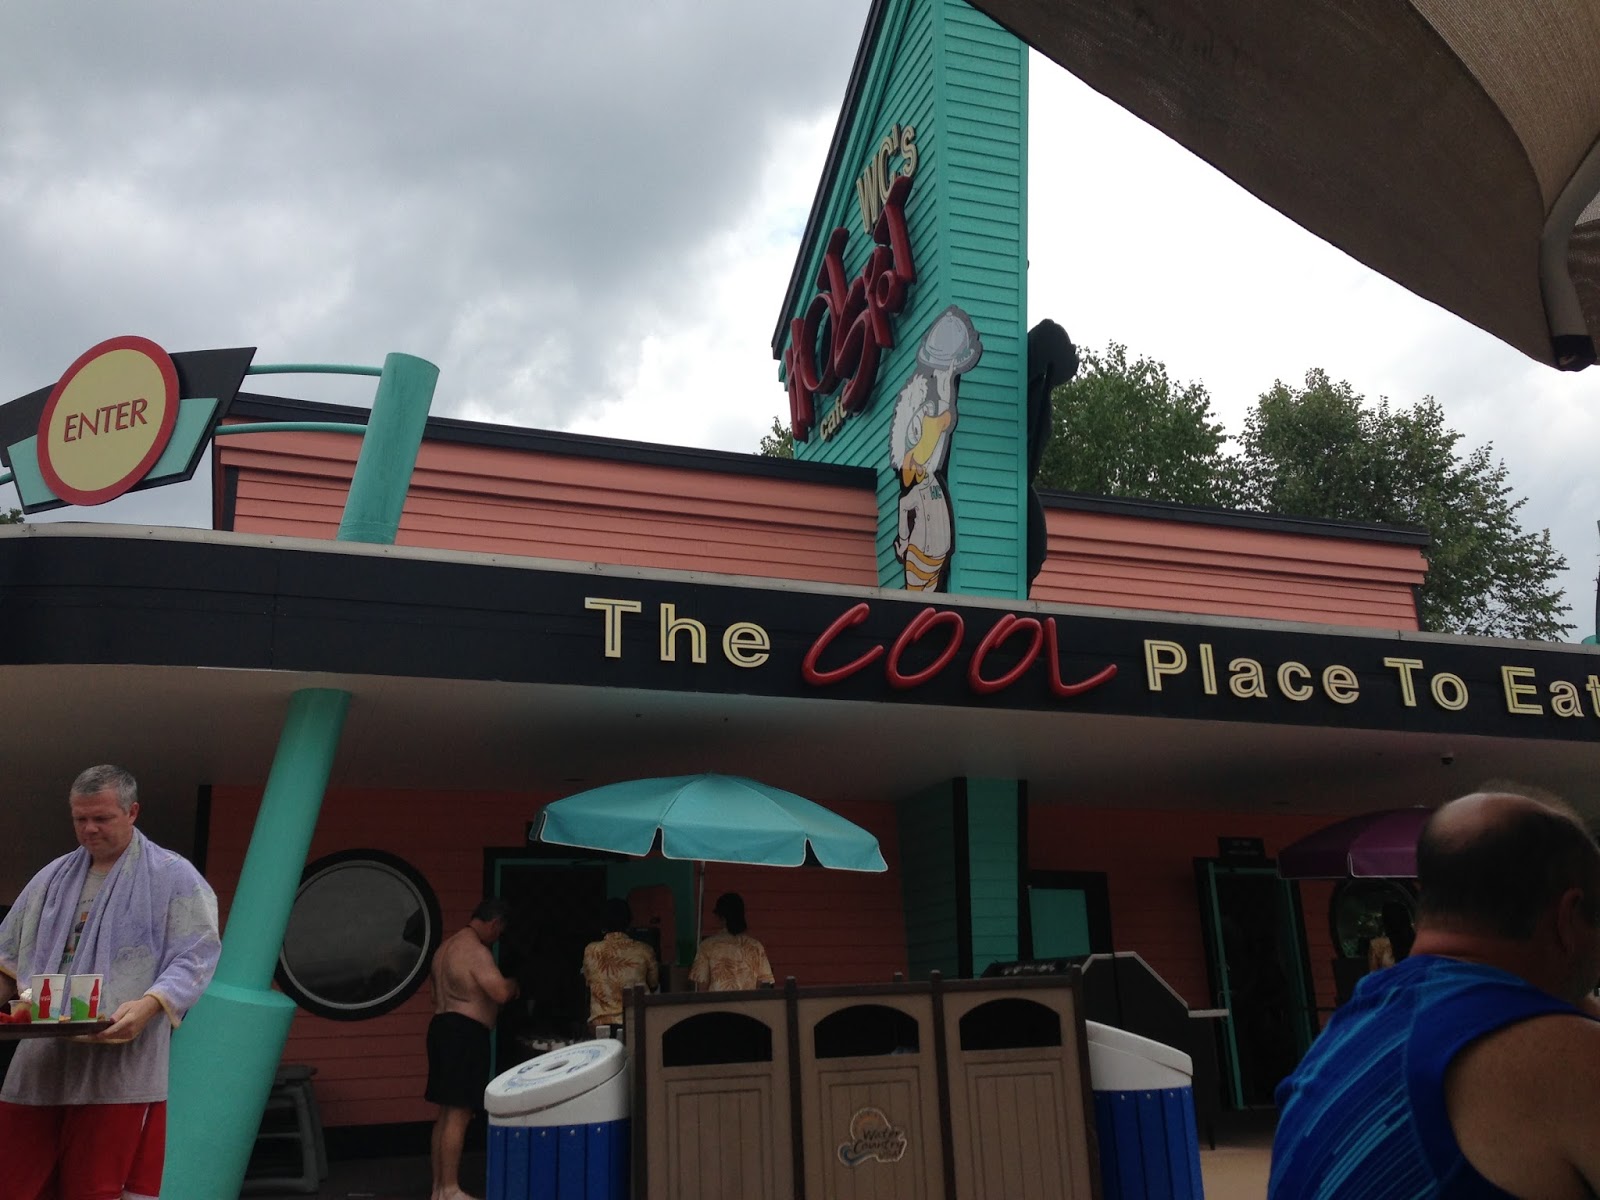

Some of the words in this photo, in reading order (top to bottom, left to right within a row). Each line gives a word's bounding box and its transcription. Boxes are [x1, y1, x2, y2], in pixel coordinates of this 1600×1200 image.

[856, 123, 917, 235] WC's
[63, 398, 148, 442] ENTER
[584, 597, 771, 668] The
[1143, 639, 1360, 704] Place
[1384, 657, 1469, 711] To
[1501, 665, 1600, 718] Eat
